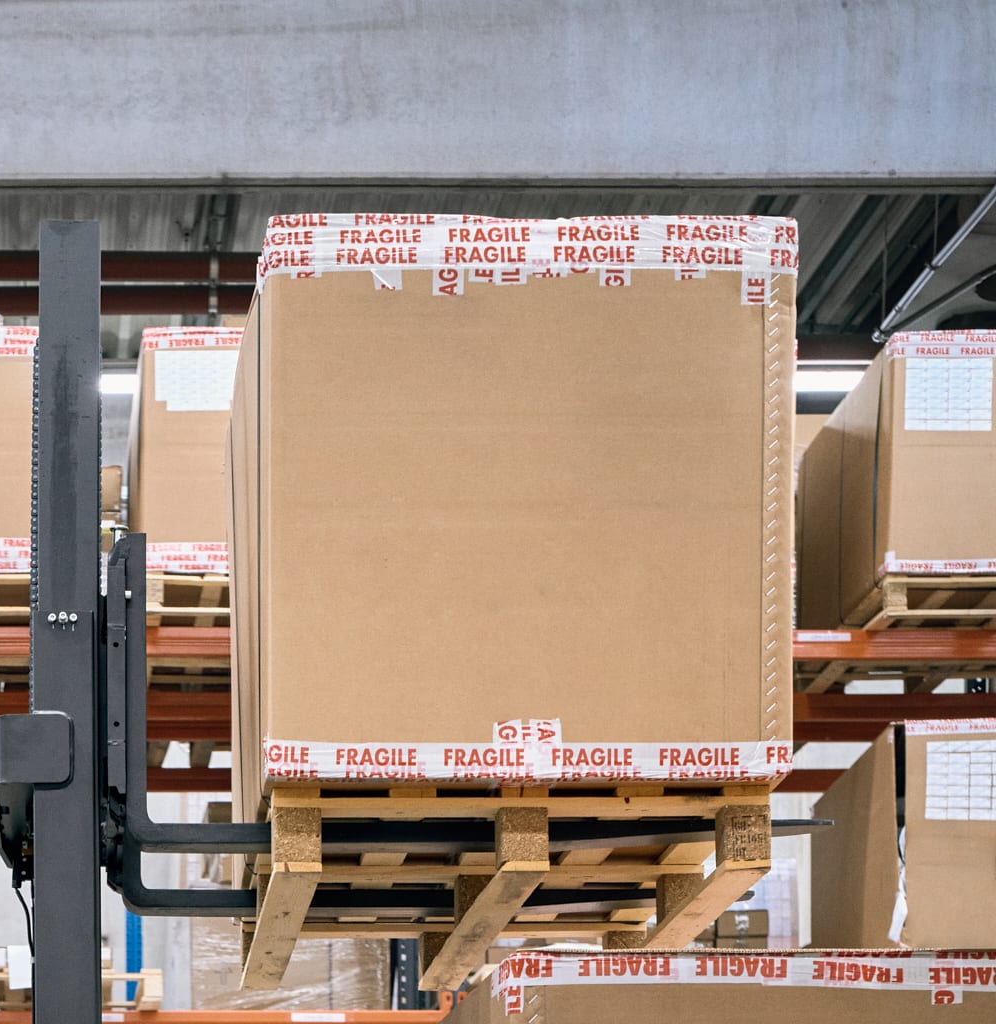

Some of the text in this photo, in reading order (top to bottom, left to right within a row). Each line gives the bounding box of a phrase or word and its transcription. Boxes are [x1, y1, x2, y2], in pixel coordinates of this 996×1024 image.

[340, 229, 422, 244] FRAGILE
[448, 227, 530, 242] FRAGILE
[557, 225, 640, 241] FRAGILE
[666, 225, 748, 243] FRAGILE
[336, 247, 417, 265] FRAGILE
[444, 246, 526, 263] FRAGILE
[554, 246, 635, 262] FRAGILE
[662, 247, 743, 265] FRAGILE
[916, 347, 950, 355] FRAGILE
[961, 347, 994, 355] FRAGILE
[336, 748, 417, 766] FRAGILE
[444, 748, 525, 766] FRAGILE
[552, 748, 632, 766] FRAGILE
[659, 748, 739, 766] FRAGILE
[578, 956, 670, 976] FRAGILE
[695, 956, 788, 978] FRAGILE
[812, 960, 904, 984] FRAGILE
